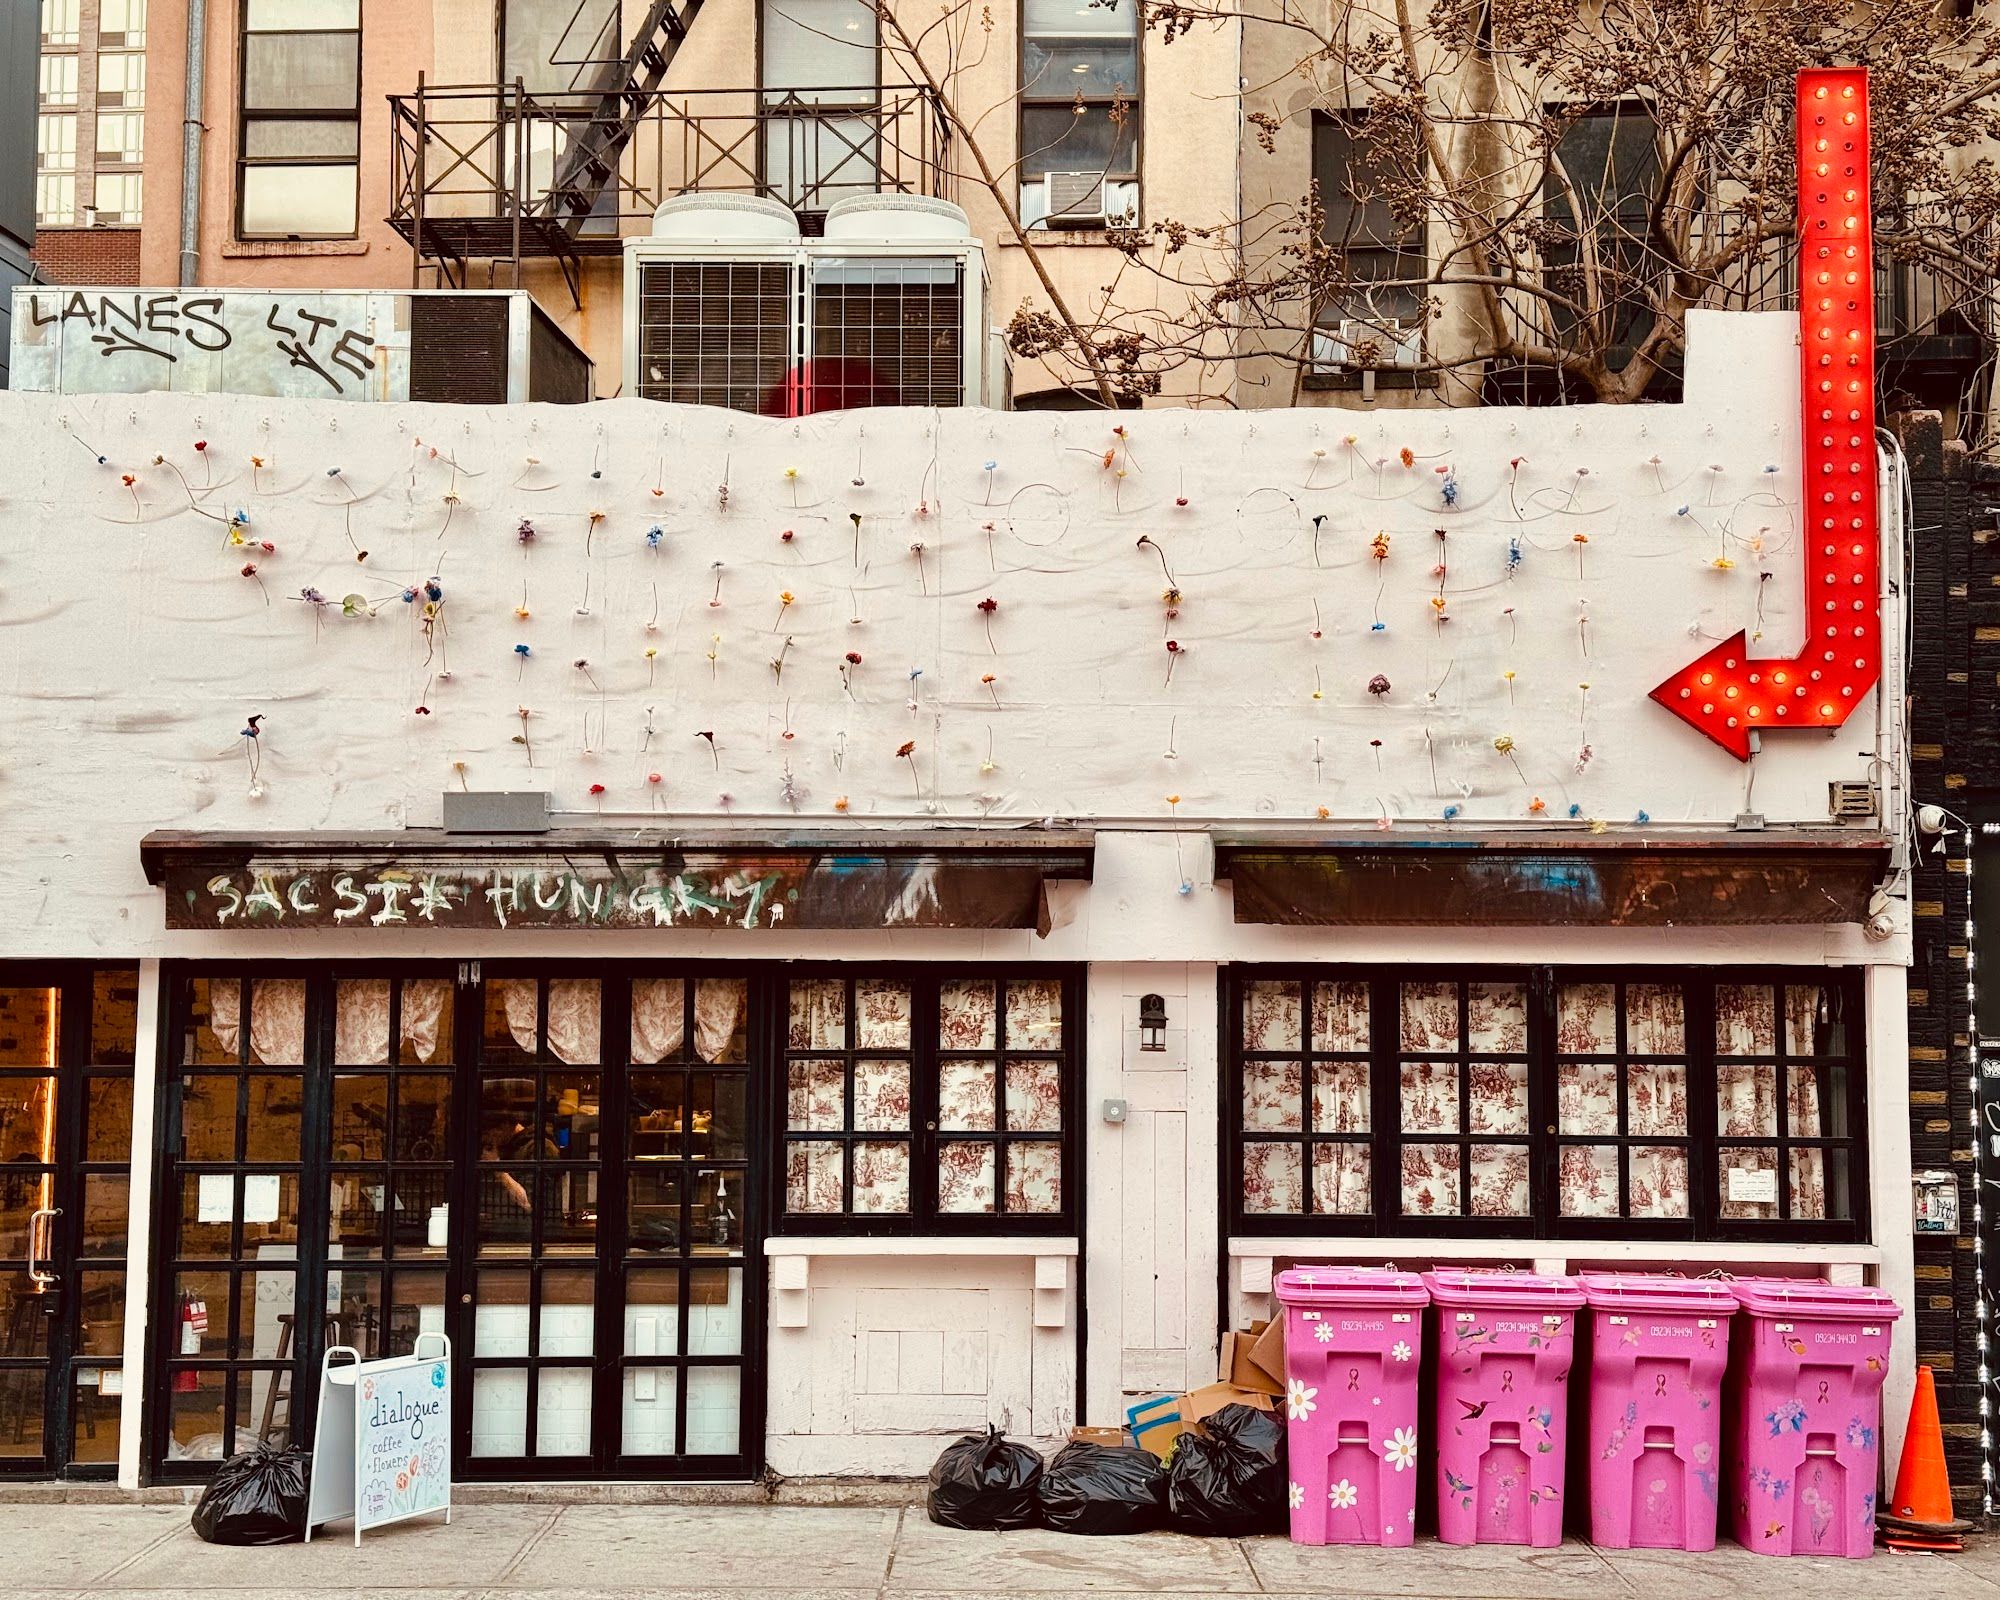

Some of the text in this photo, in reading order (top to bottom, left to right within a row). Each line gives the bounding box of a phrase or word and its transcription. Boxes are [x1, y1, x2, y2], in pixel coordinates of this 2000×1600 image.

[30, 292, 232, 350] LANES
[370, 1391, 439, 1440] dialogue
[372, 1435, 403, 1455] coffee
[372, 1455, 409, 1474] flowers
